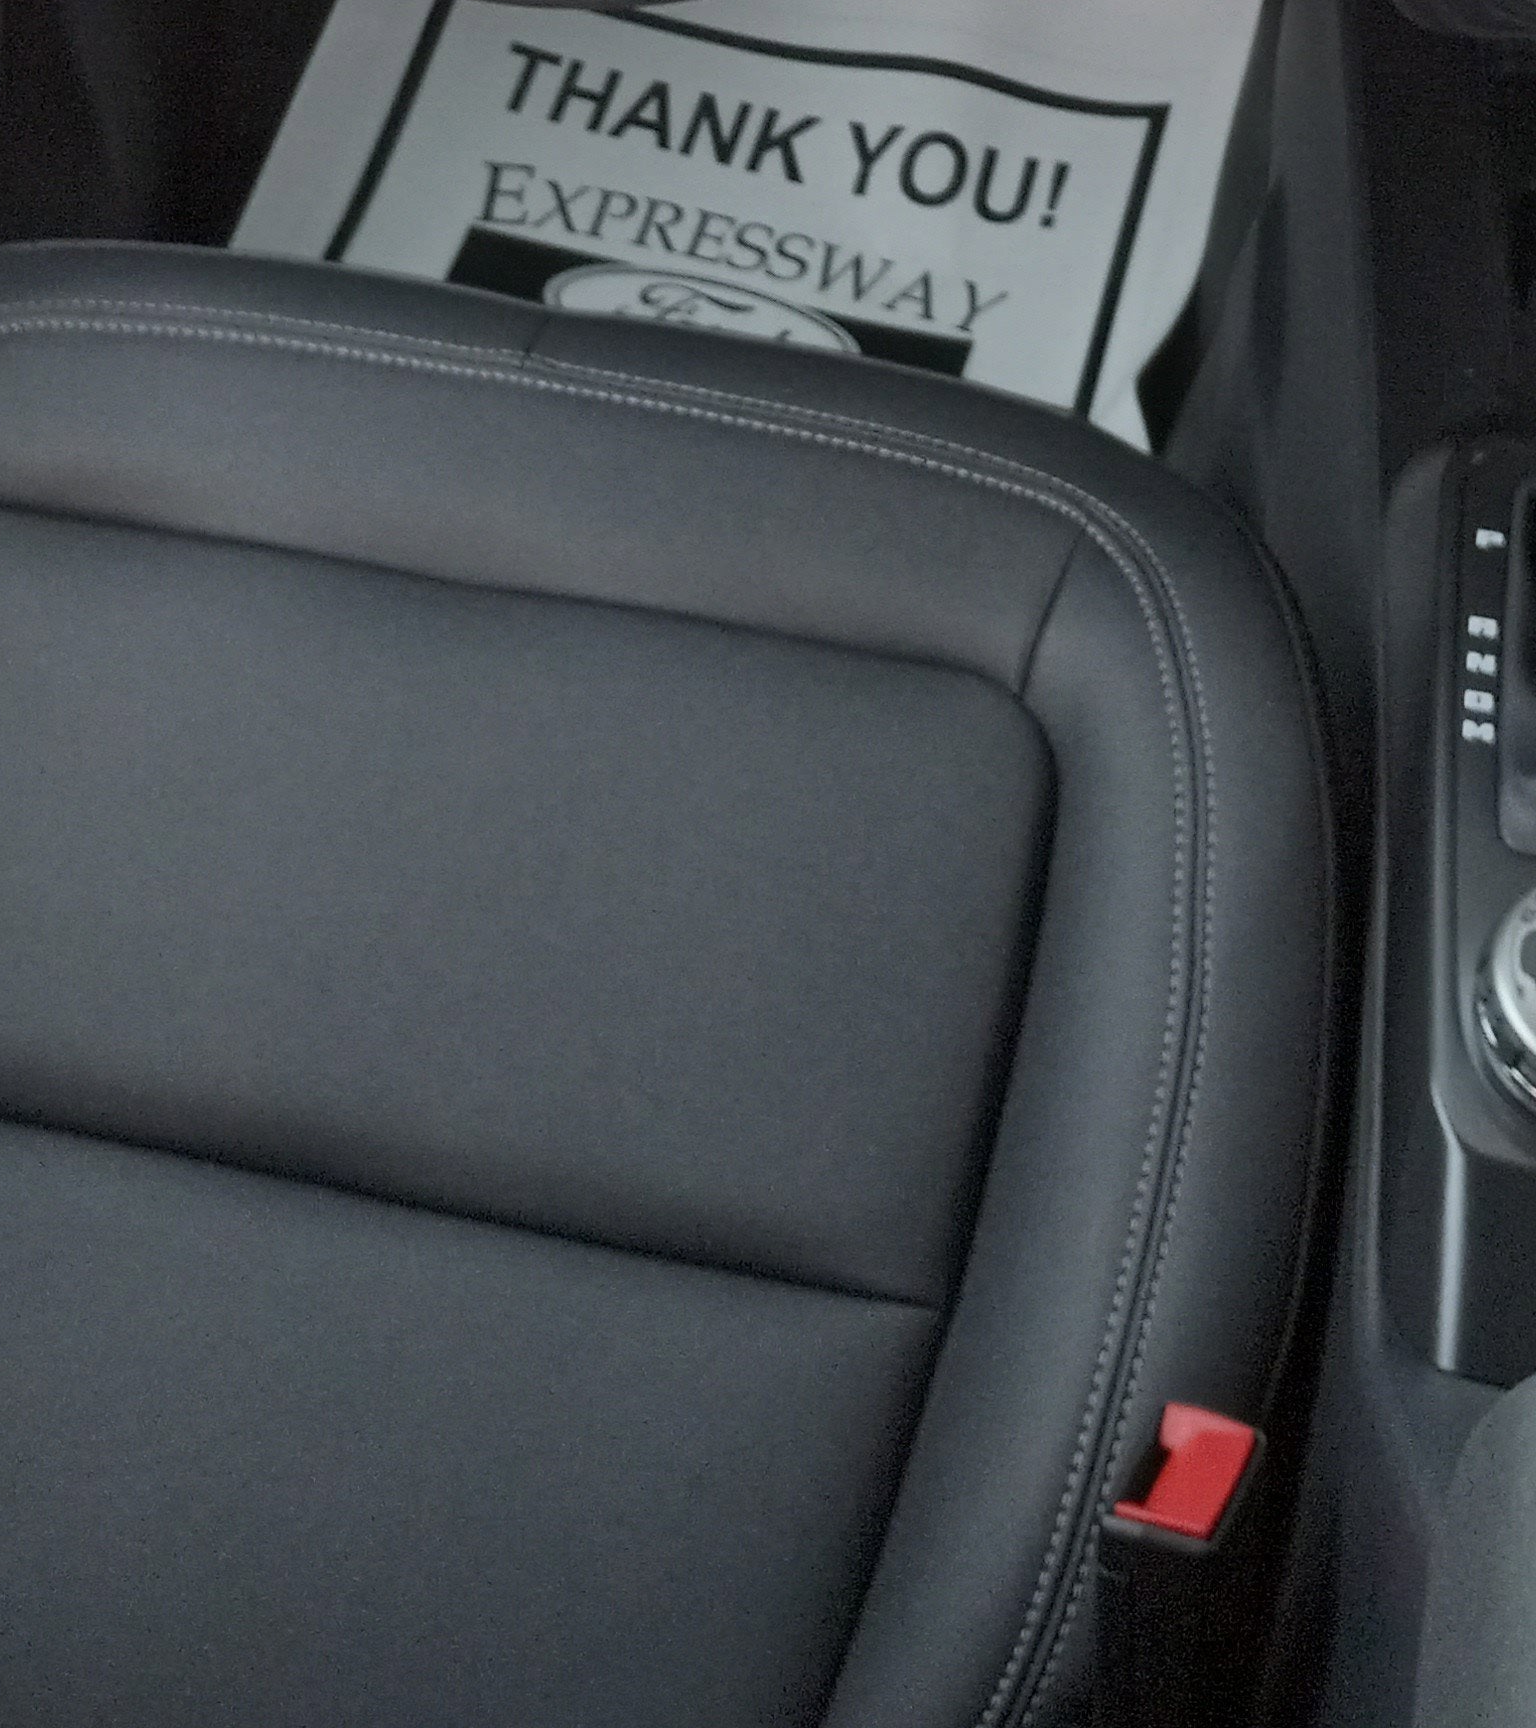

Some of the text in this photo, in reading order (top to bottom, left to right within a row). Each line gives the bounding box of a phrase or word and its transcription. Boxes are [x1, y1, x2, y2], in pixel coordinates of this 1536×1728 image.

[507, 40, 1071, 229] THANK YOU!
[476, 159, 1009, 335] EXPRESSWAY
